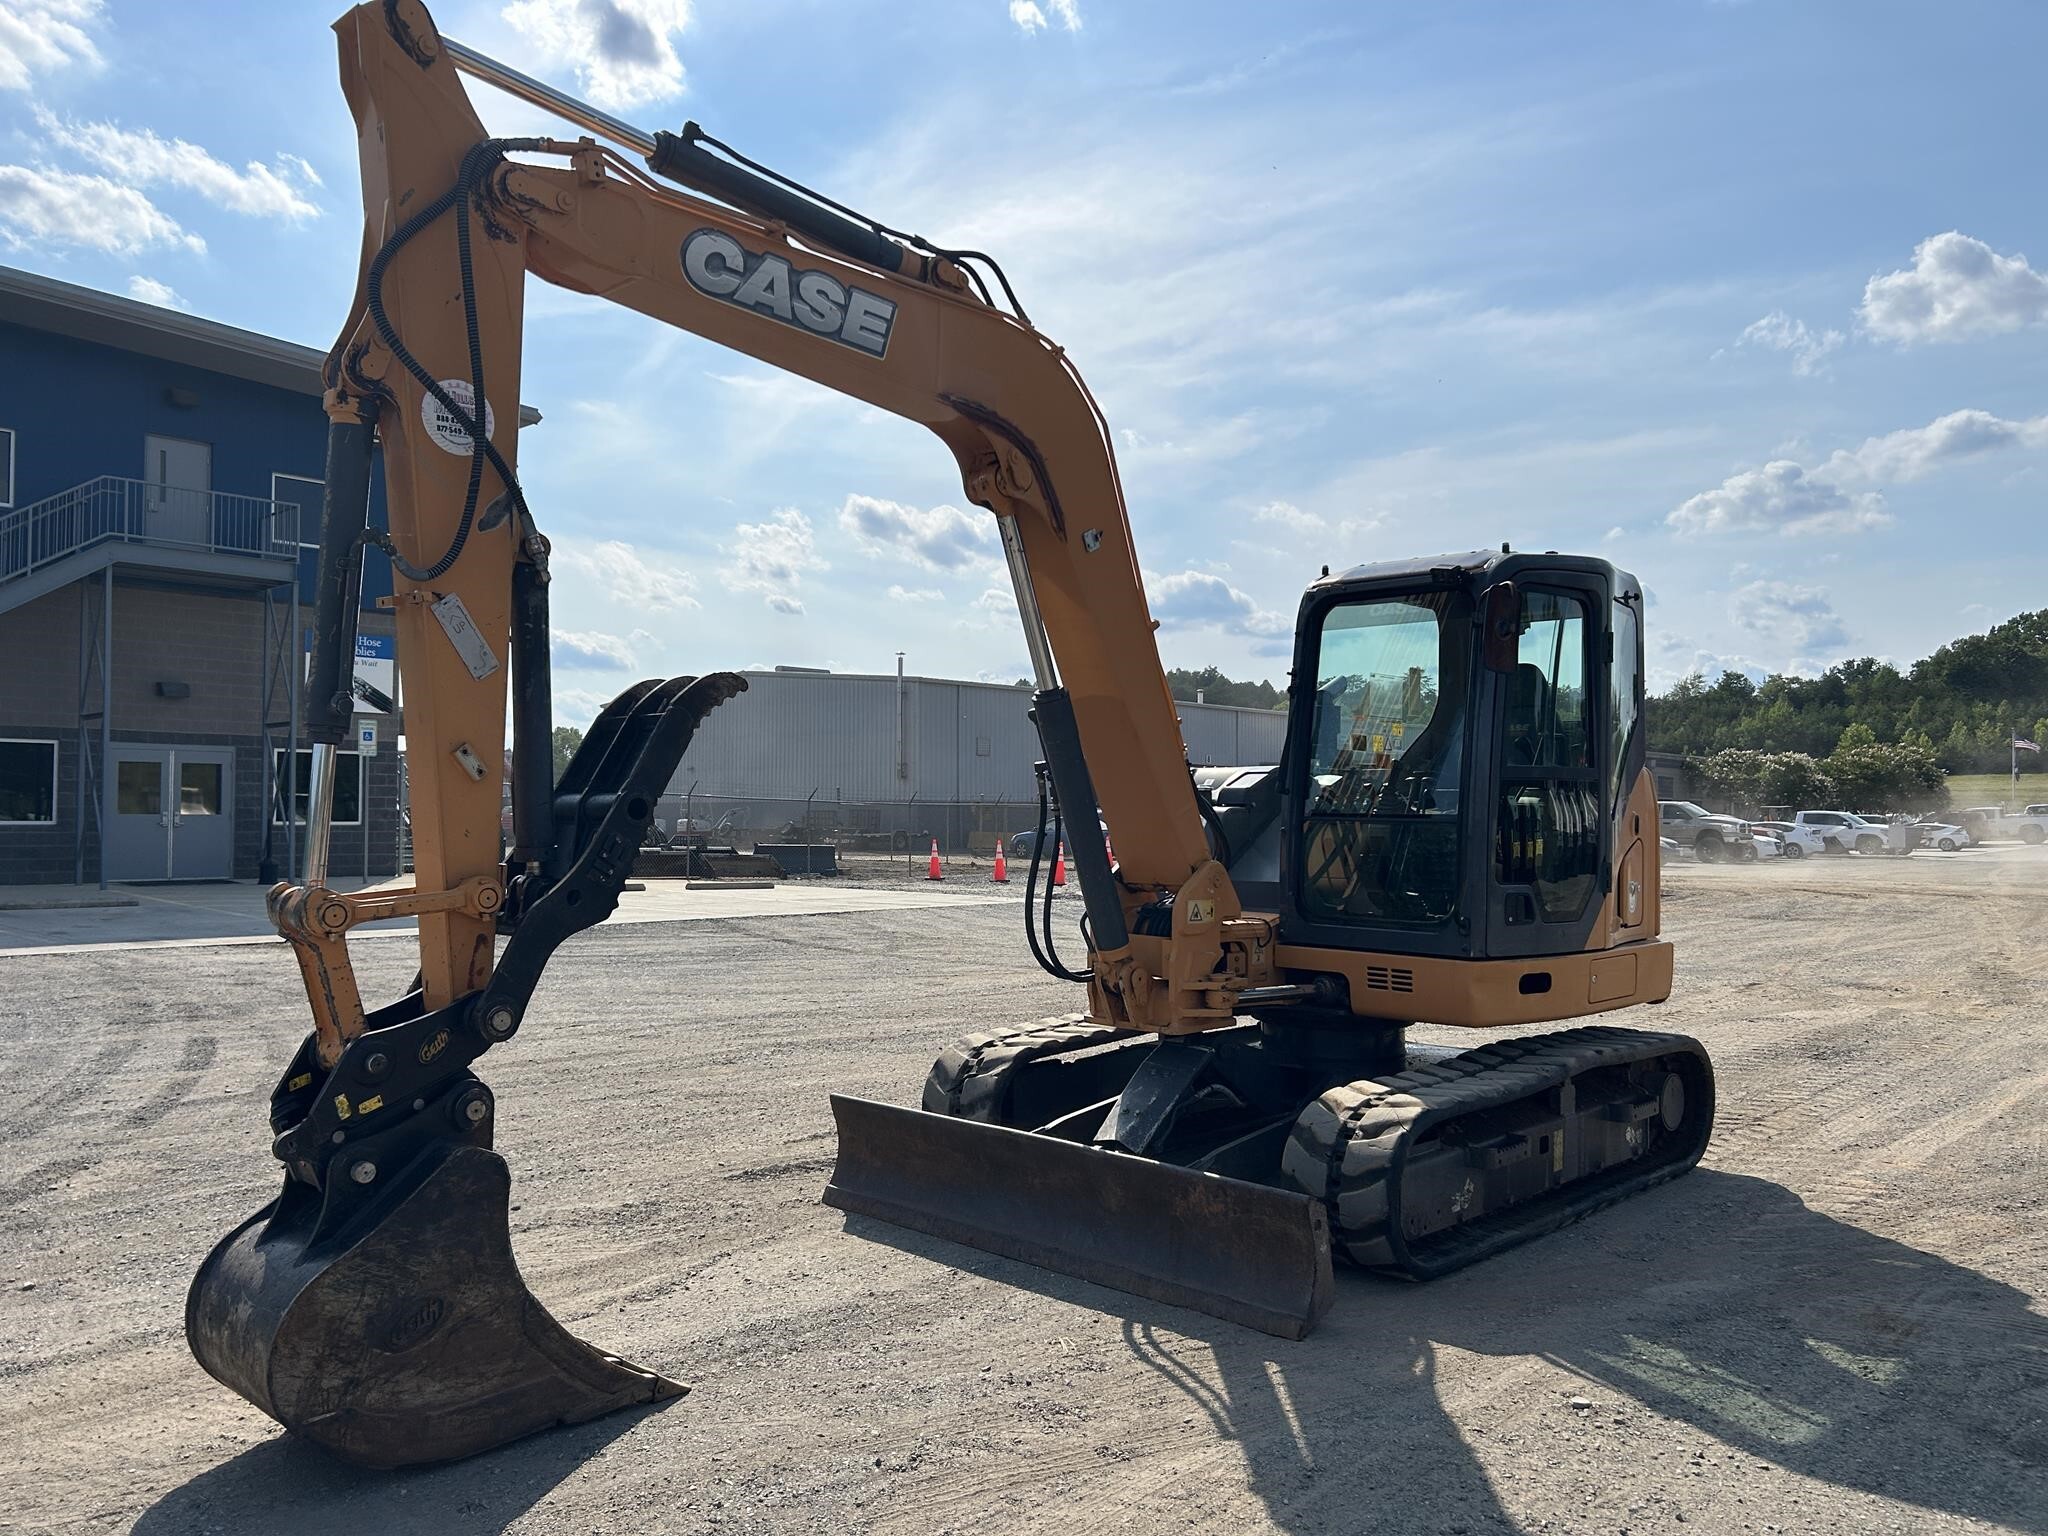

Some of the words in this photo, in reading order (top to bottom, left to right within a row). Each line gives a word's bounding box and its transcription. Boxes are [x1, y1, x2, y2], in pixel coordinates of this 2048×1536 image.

[683, 232, 895, 355] CASE
[452, 621, 466, 634] UP
[358, 636, 382, 647] Hose
[361, 659, 378, 667] Wait
